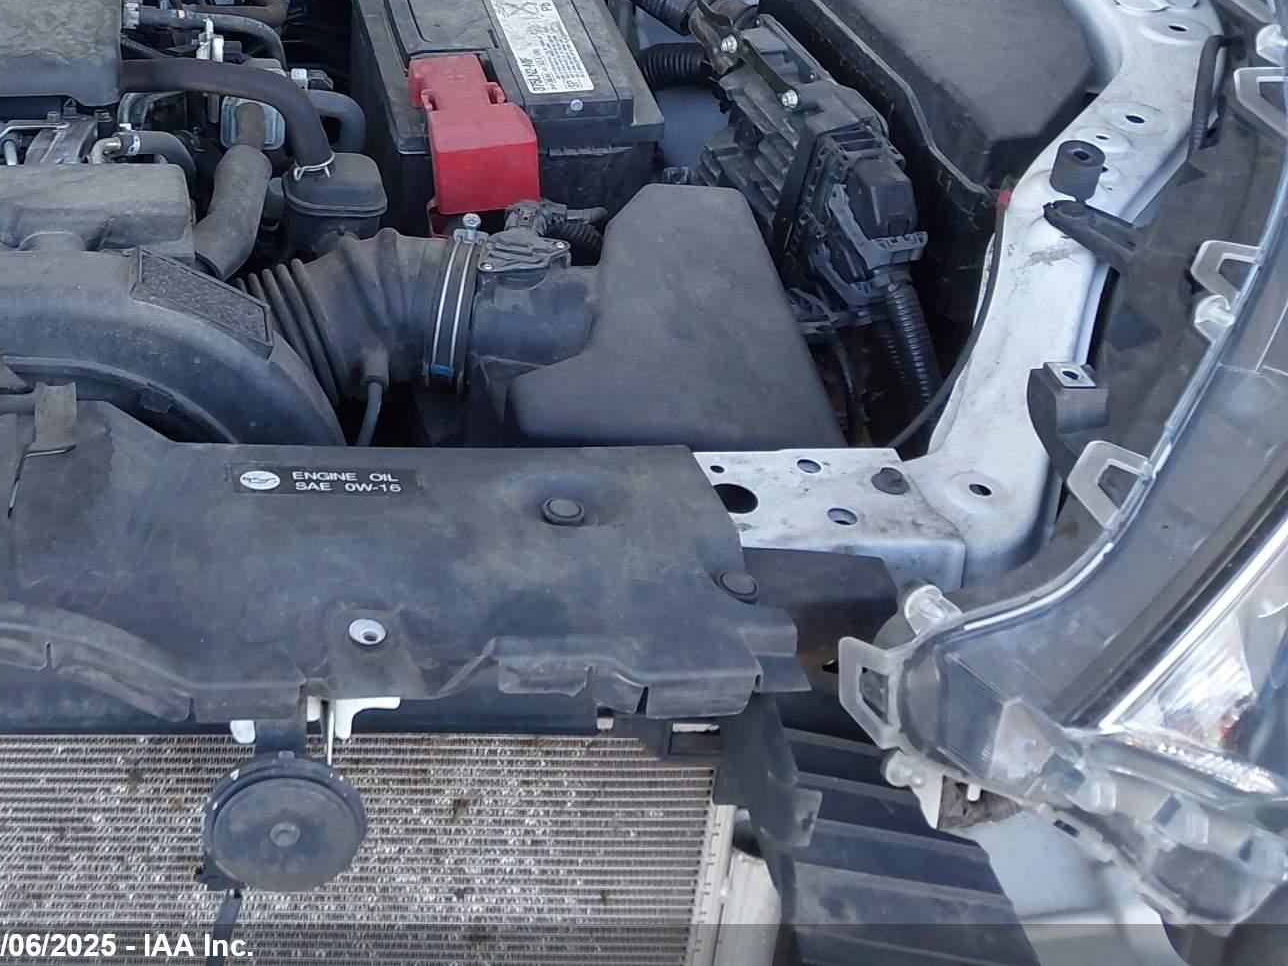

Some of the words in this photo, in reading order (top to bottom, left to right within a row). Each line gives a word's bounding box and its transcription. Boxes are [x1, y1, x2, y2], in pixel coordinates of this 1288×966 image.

[292, 471, 358, 482] ENGINE
[369, 473, 400, 482] OIL
[295, 482, 332, 492] SAE
[344, 483, 402, 493] 0W-16
